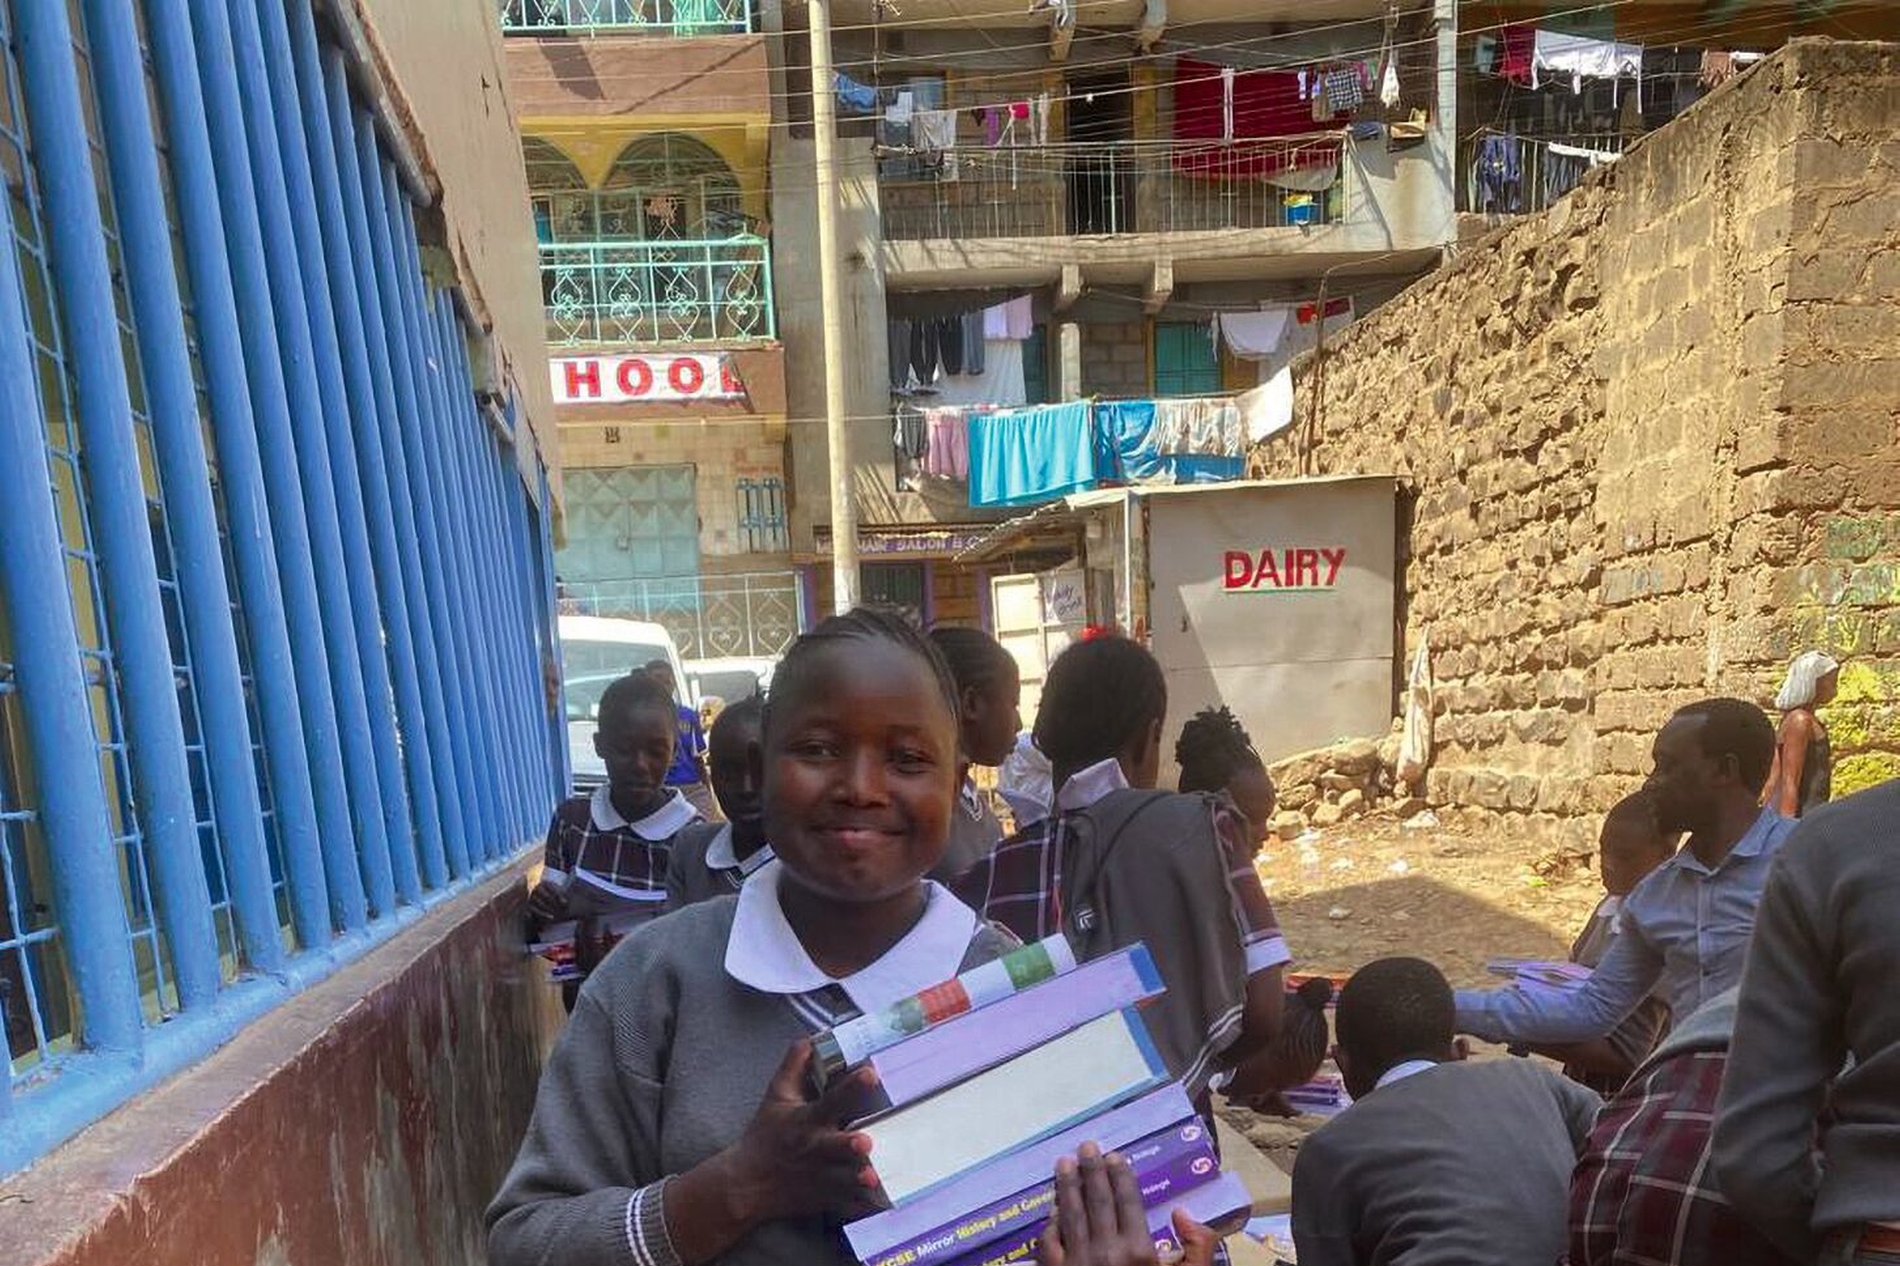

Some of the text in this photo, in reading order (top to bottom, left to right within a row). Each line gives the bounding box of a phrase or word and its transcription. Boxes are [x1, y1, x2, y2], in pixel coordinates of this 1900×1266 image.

[1224, 548, 1347, 589] DAIRY
[916, 1232, 955, 1259] Mirror
[956, 1216, 997, 1240] History
[998, 1206, 1021, 1223] and
